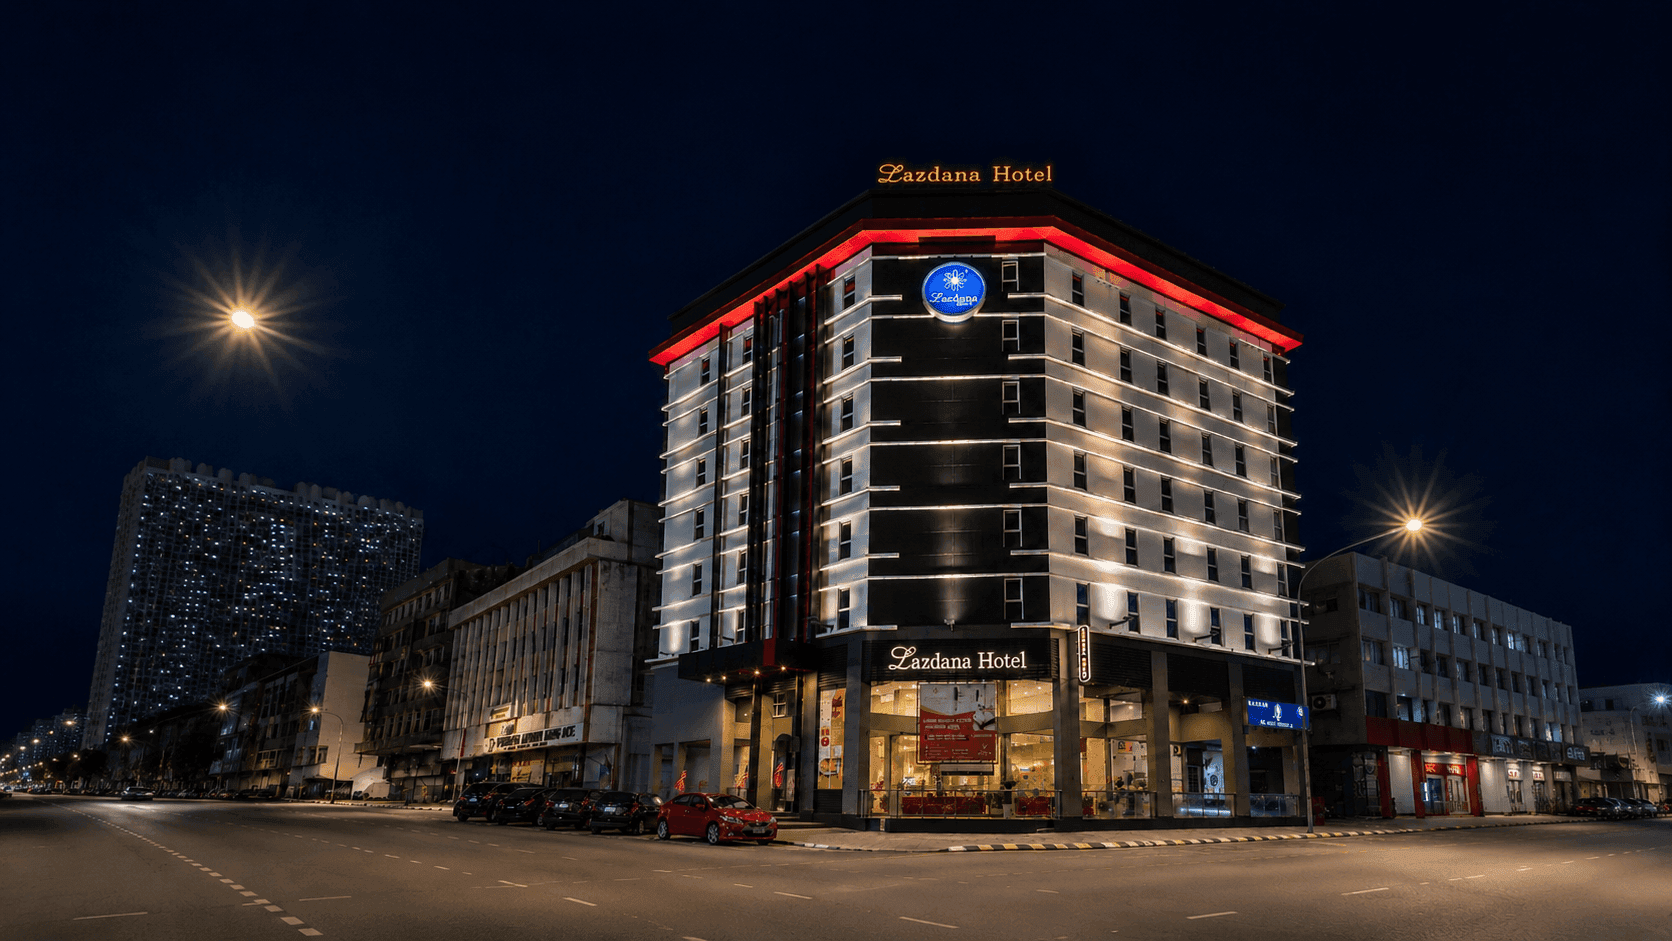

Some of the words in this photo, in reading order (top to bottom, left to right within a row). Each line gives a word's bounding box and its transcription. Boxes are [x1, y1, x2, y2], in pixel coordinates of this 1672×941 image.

[877, 163, 980, 183] Lazdana
[993, 165, 1052, 182] Hotel
[888, 645, 972, 671] Lazdana
[977, 650, 1028, 670] Hotel
